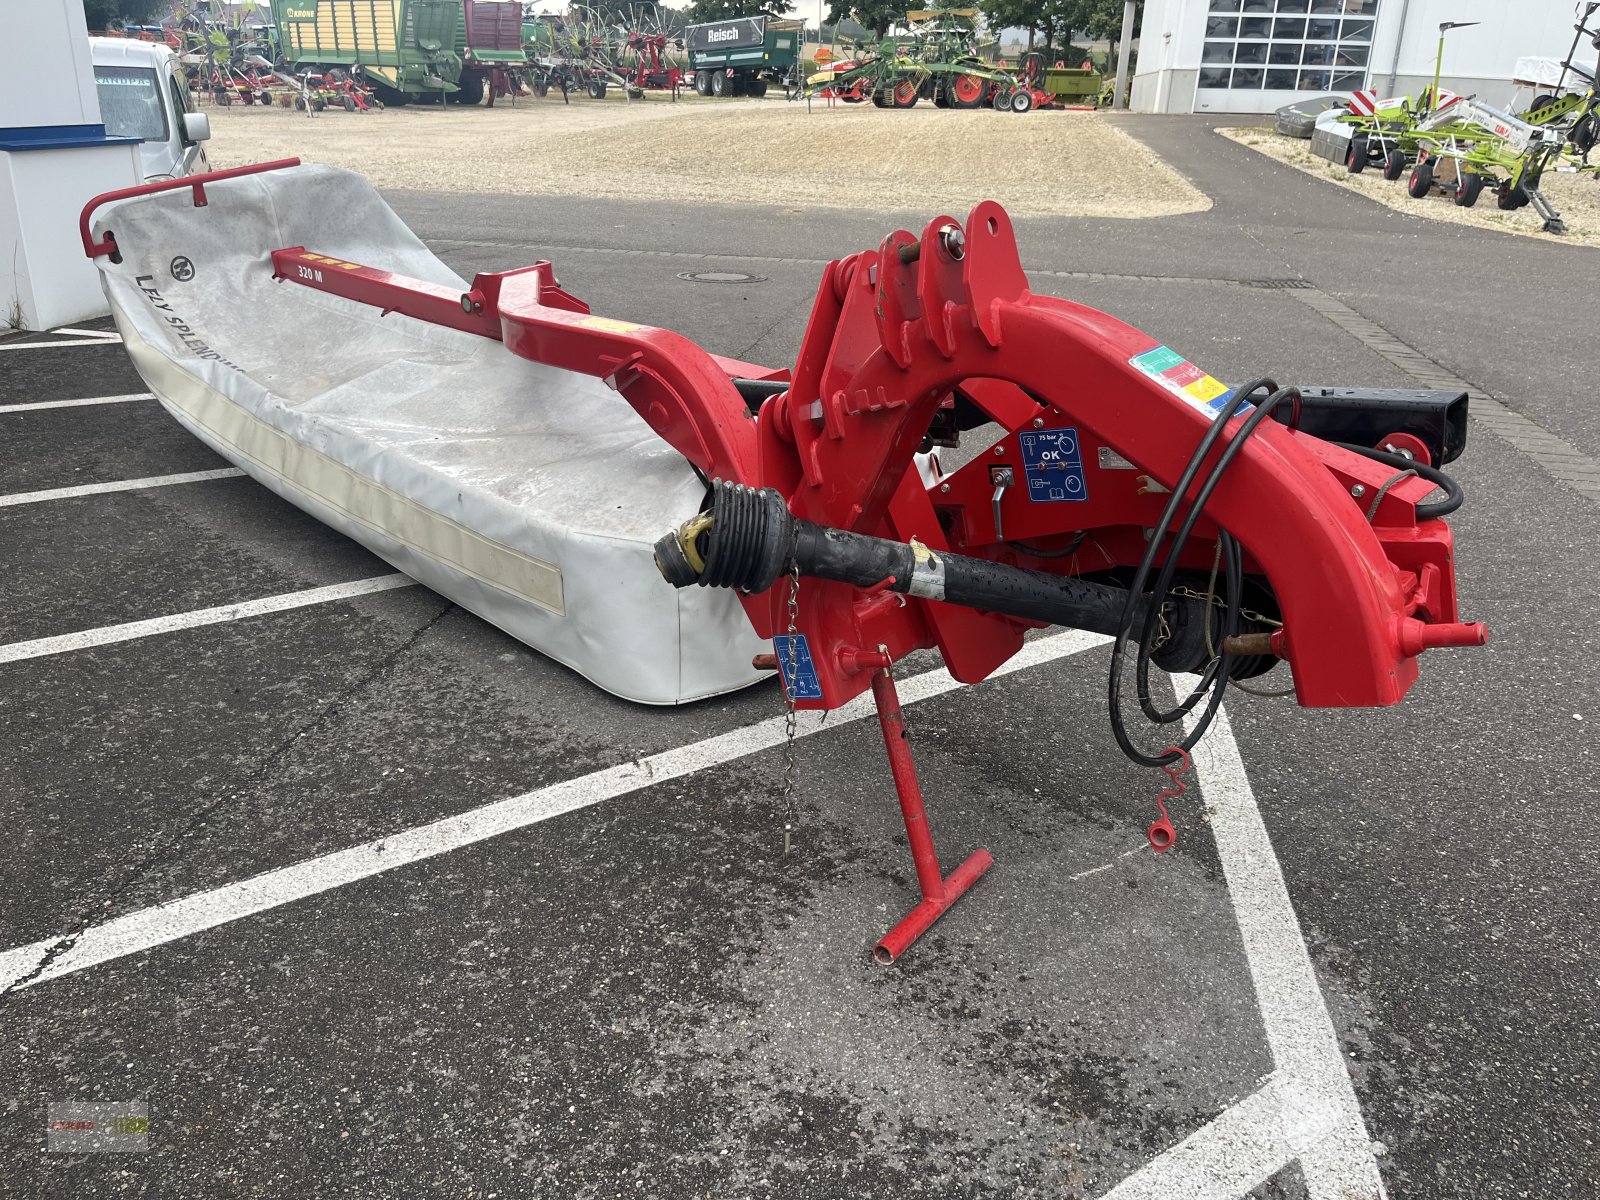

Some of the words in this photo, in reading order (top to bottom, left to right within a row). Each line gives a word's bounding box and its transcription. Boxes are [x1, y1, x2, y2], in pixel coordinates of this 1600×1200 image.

[293, 10, 315, 18] KRONE
[708, 26, 739, 43] Reisch
[298, 265, 313, 280] 320
[314, 269, 323, 284] M
[135, 274, 174, 312] LELY
[1041, 450, 1061, 461] OK
